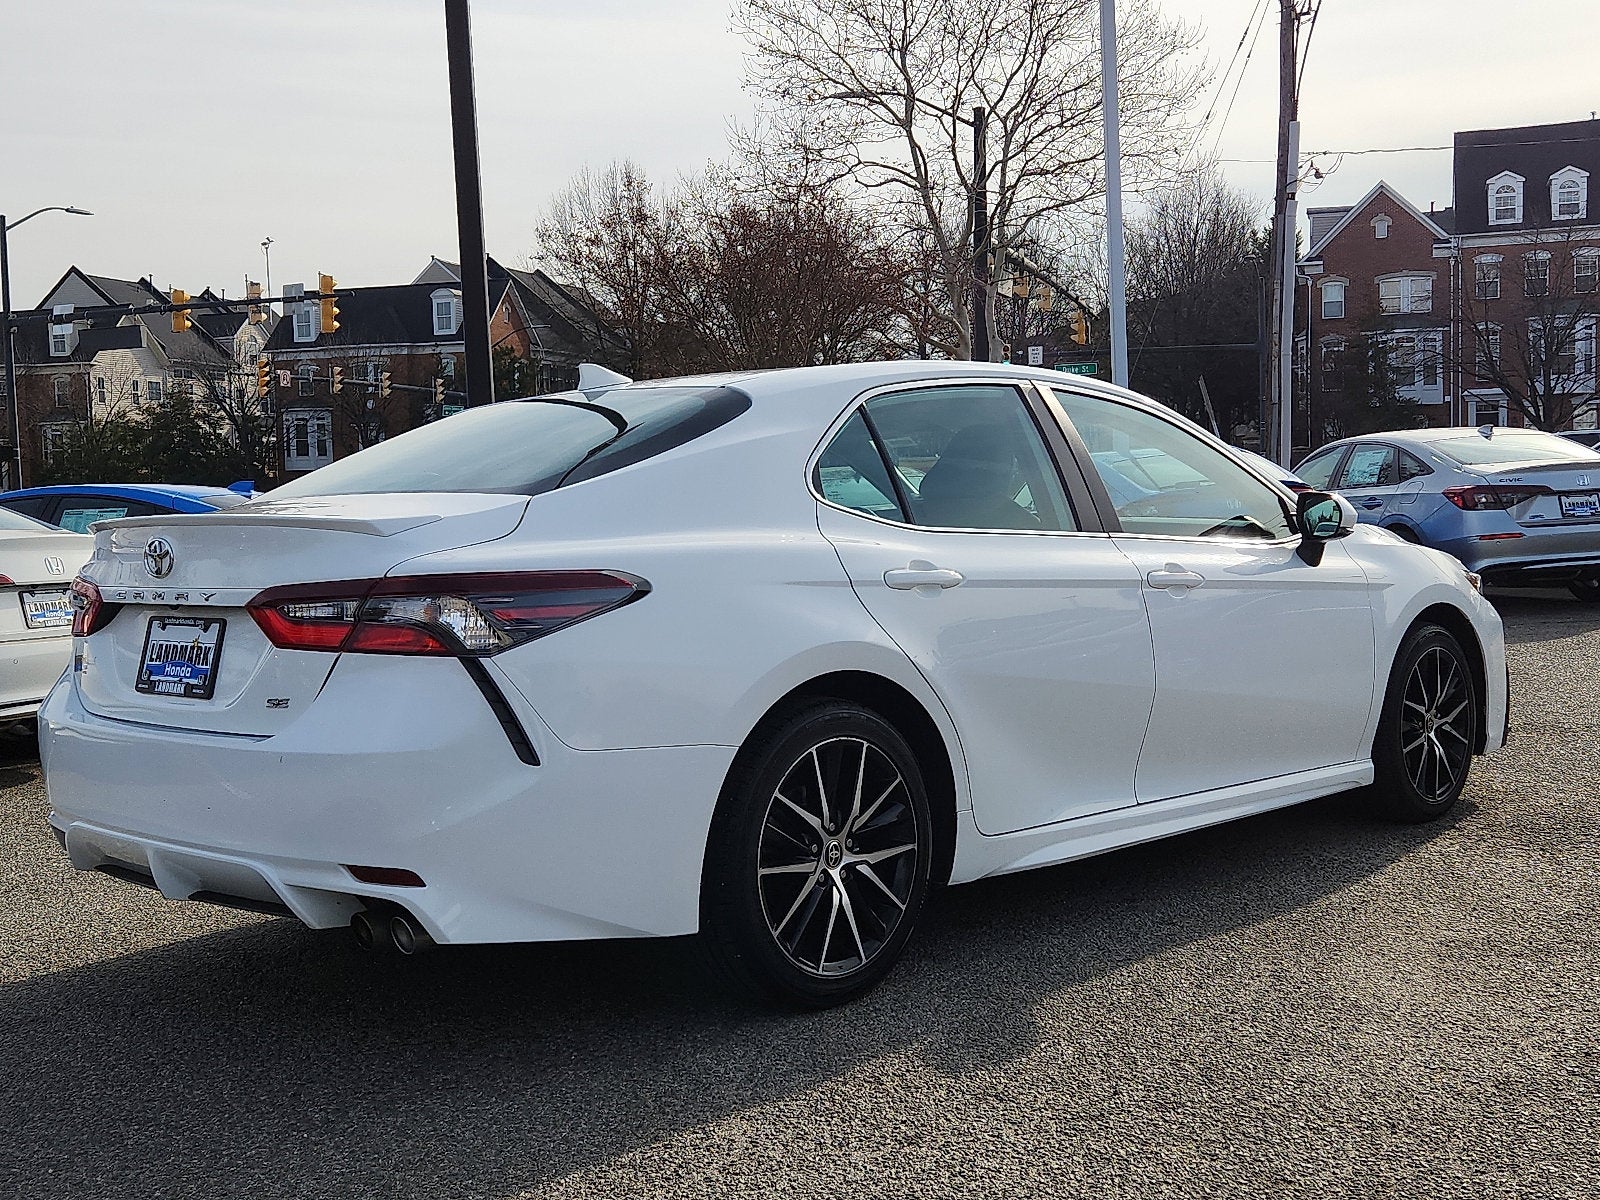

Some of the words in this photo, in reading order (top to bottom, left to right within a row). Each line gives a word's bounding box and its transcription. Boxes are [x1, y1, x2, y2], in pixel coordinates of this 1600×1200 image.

[1062, 366, 1079, 374] Duke
[115, 589, 217, 602] CAMRY
[148, 641, 212, 667] LANDMARK
[164, 664, 192, 677] Honda
[154, 681, 186, 695] LANDMARK
